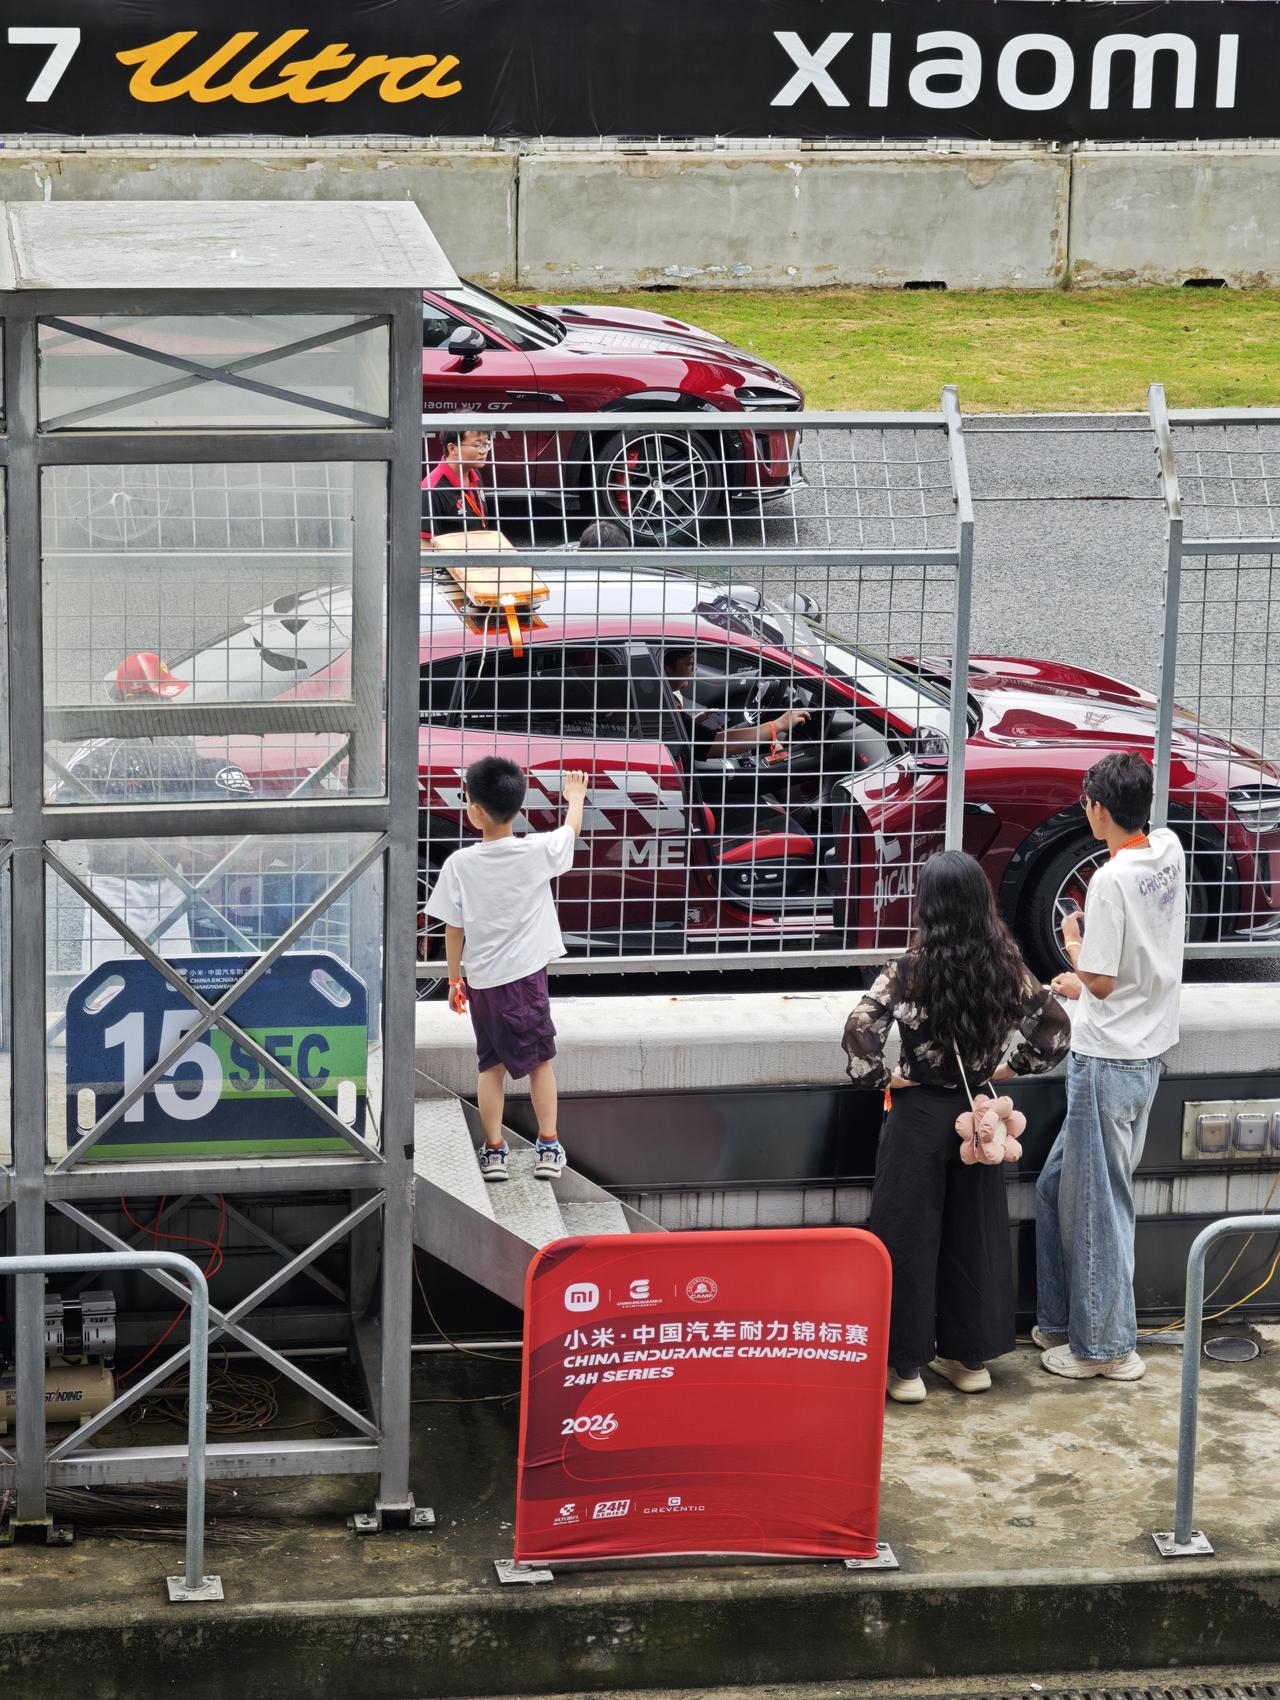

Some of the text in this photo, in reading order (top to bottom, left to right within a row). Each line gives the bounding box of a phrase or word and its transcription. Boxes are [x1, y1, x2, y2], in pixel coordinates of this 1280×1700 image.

[8, 27, 462, 104] 7 Ultra
[423, 401, 457, 410] iaomi
[487, 402, 512, 410] GT
[622, 840, 686, 869] ME
[105, 1010, 330, 1122] 15 SEC
[563, 1320, 869, 1351] 小米·中国汽车耐力锦标赛
[563, 1346, 868, 1368] CHINA ENDURANCE CHAMPIONSHIP
[563, 1366, 675, 1388] 24H SERIES
[560, 1412, 619, 1436] 2026
[599, 1501, 627, 1513] 24H
[643, 1505, 705, 1514] CREVENTIC
